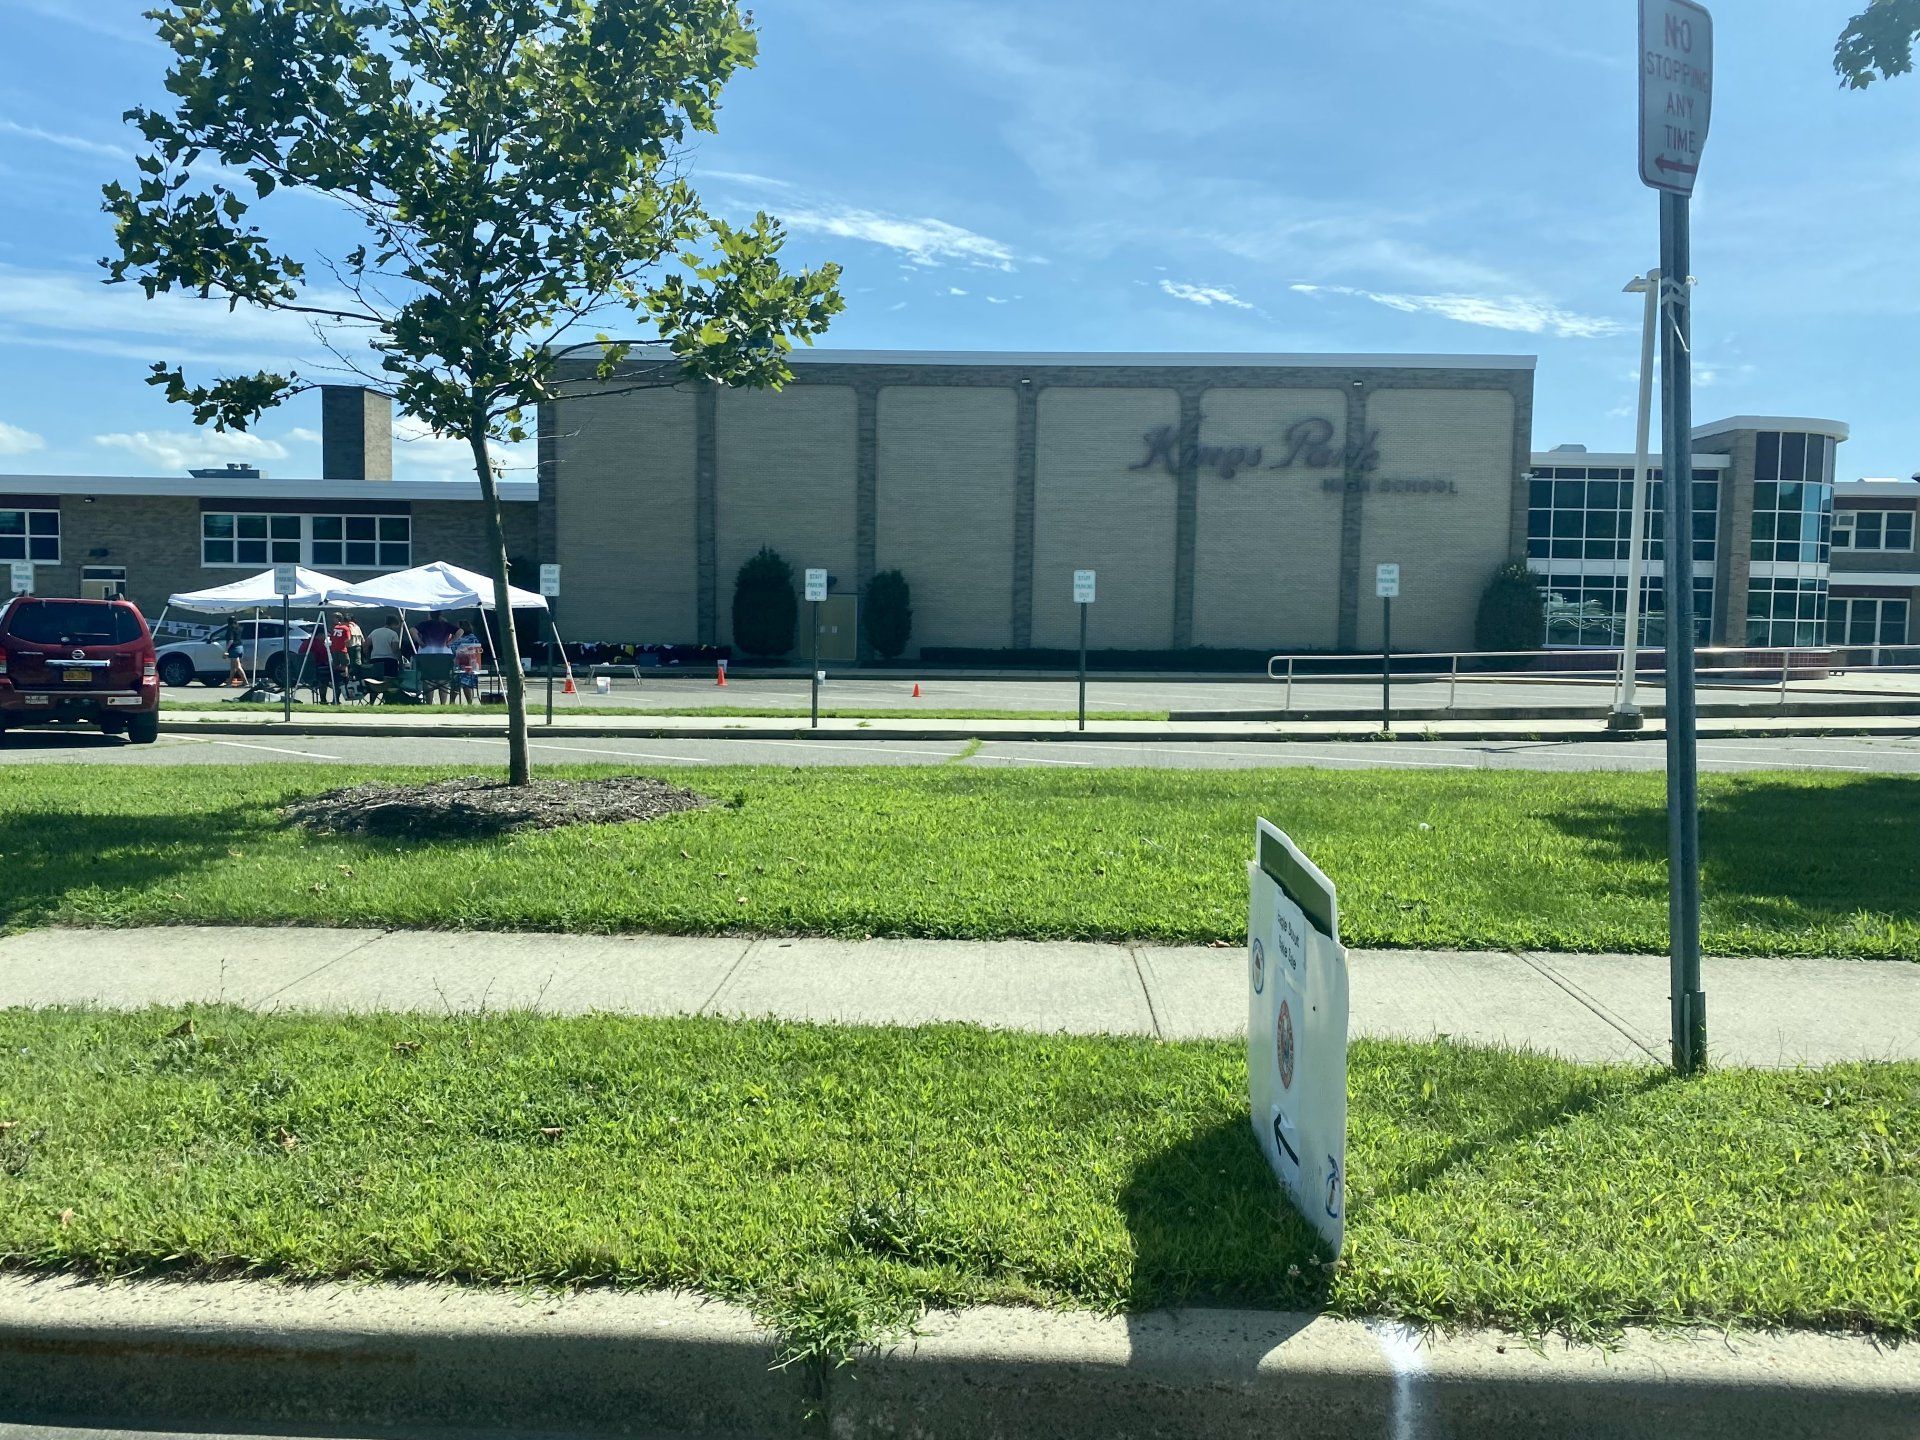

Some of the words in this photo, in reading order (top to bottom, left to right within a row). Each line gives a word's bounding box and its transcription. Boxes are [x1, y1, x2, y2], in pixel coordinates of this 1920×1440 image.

[1664, 13, 1692, 53] NO
[1646, 51, 1709, 94] STOPPING
[1666, 92, 1695, 120] ANY
[1664, 125, 1696, 154] TIME
